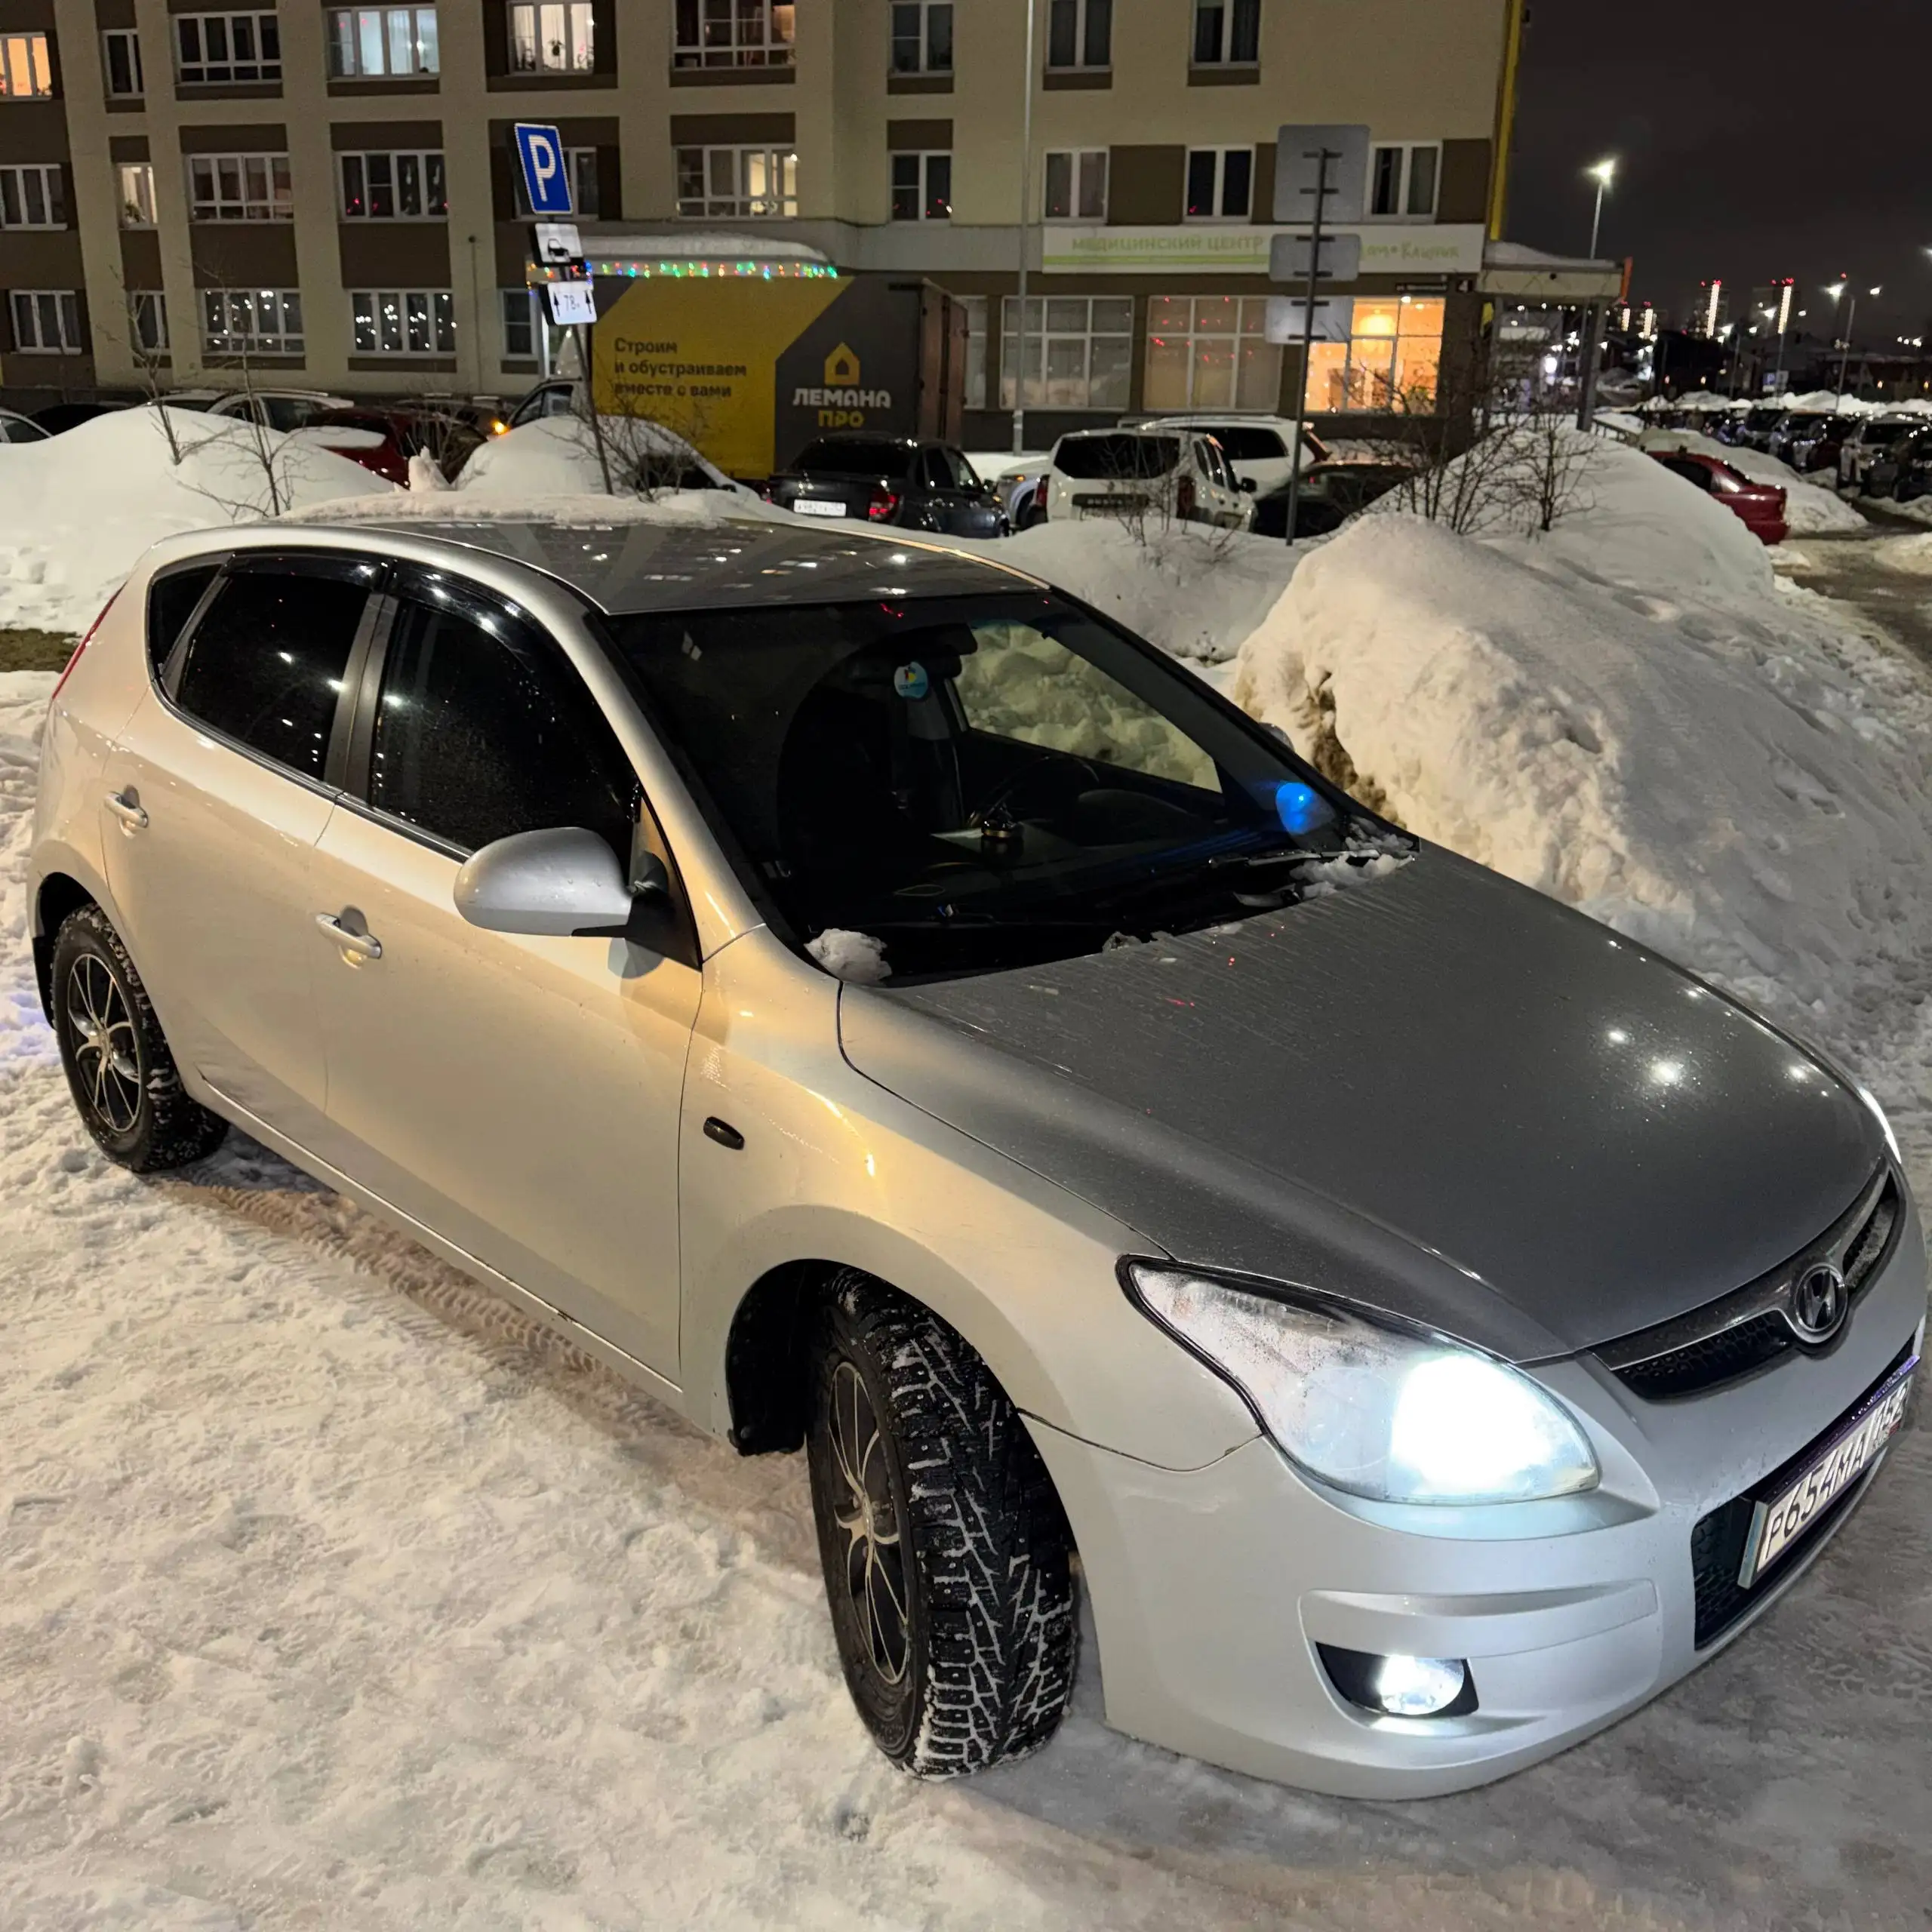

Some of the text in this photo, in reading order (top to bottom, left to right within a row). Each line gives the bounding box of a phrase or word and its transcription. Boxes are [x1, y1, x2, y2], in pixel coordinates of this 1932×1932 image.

[528, 134, 556, 202] P
[614, 337, 678, 355] Строим
[614, 360, 747, 377] и обустраиваем
[677, 385, 686, 396] с
[690, 385, 732, 397] вами
[792, 388, 891, 408] ЛЕМАНА
[818, 410, 864, 428] ПРО
